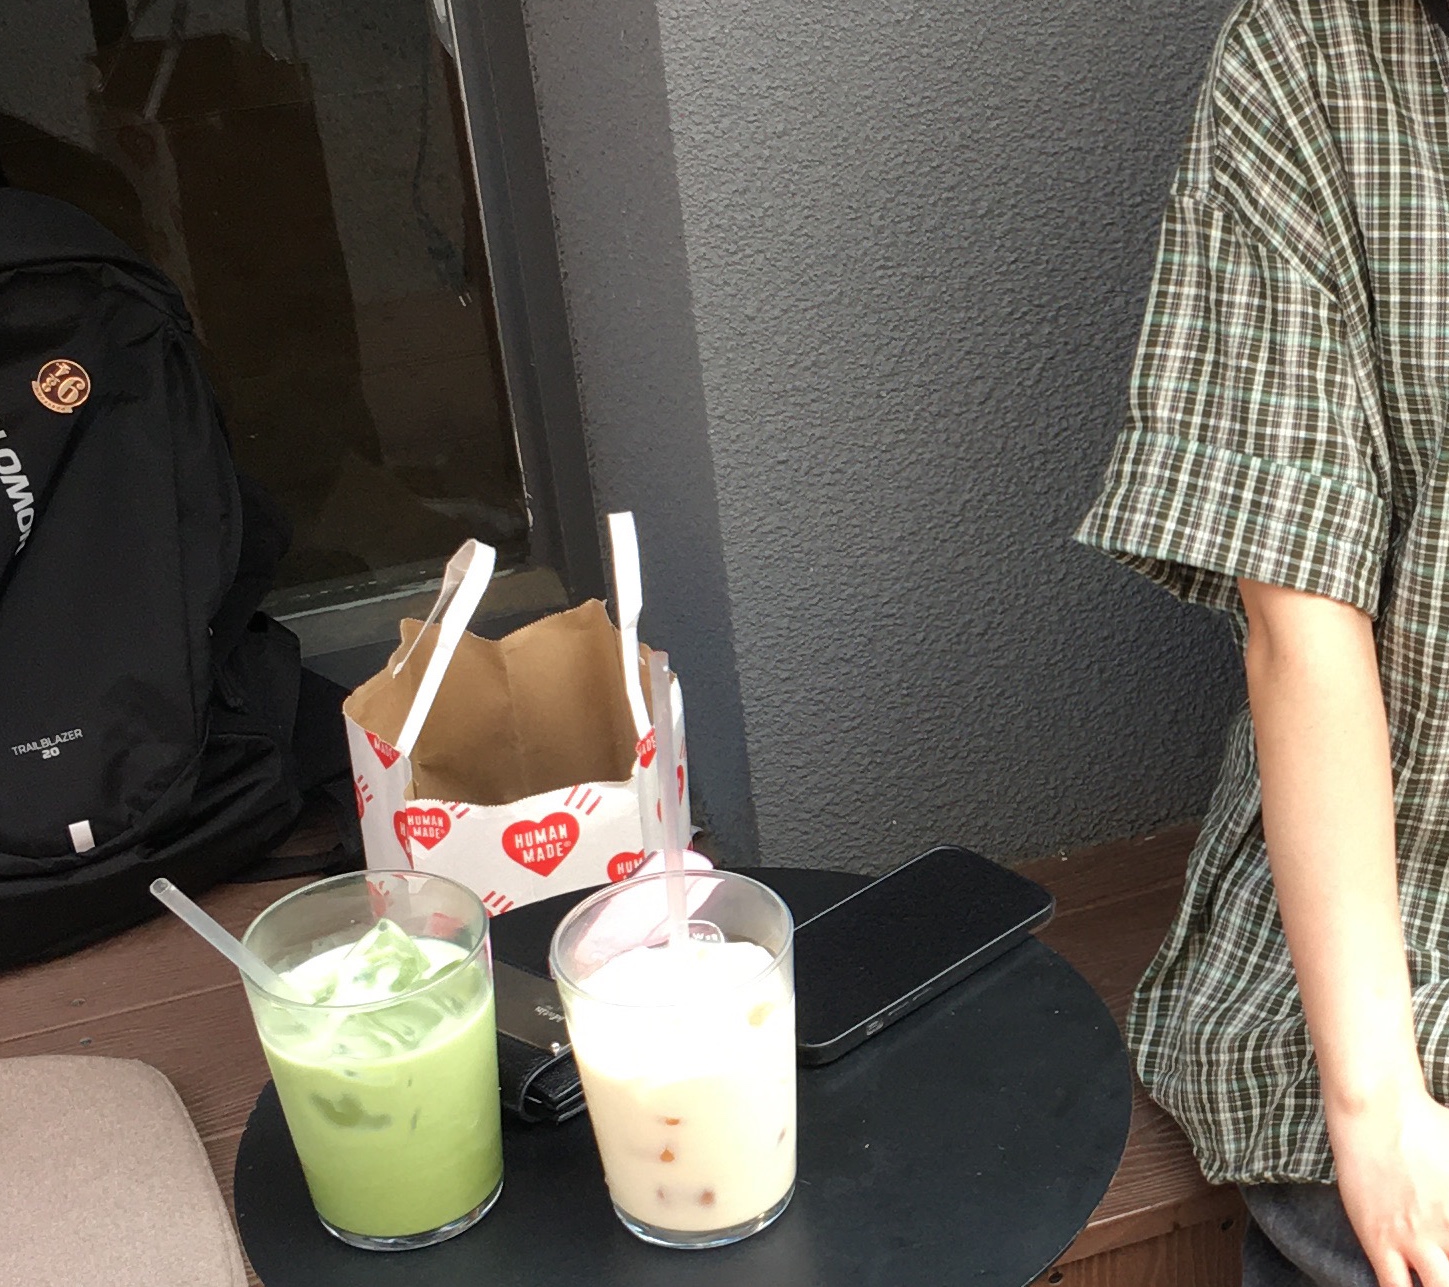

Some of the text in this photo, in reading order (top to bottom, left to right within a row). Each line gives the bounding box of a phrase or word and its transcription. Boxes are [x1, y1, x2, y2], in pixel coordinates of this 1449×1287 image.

[11, 728, 83, 756] TRAILBLAZER
[41, 746, 61, 760] 20
[407, 814, 444, 828] HUMAN
[514, 823, 568, 849] HUMAN
